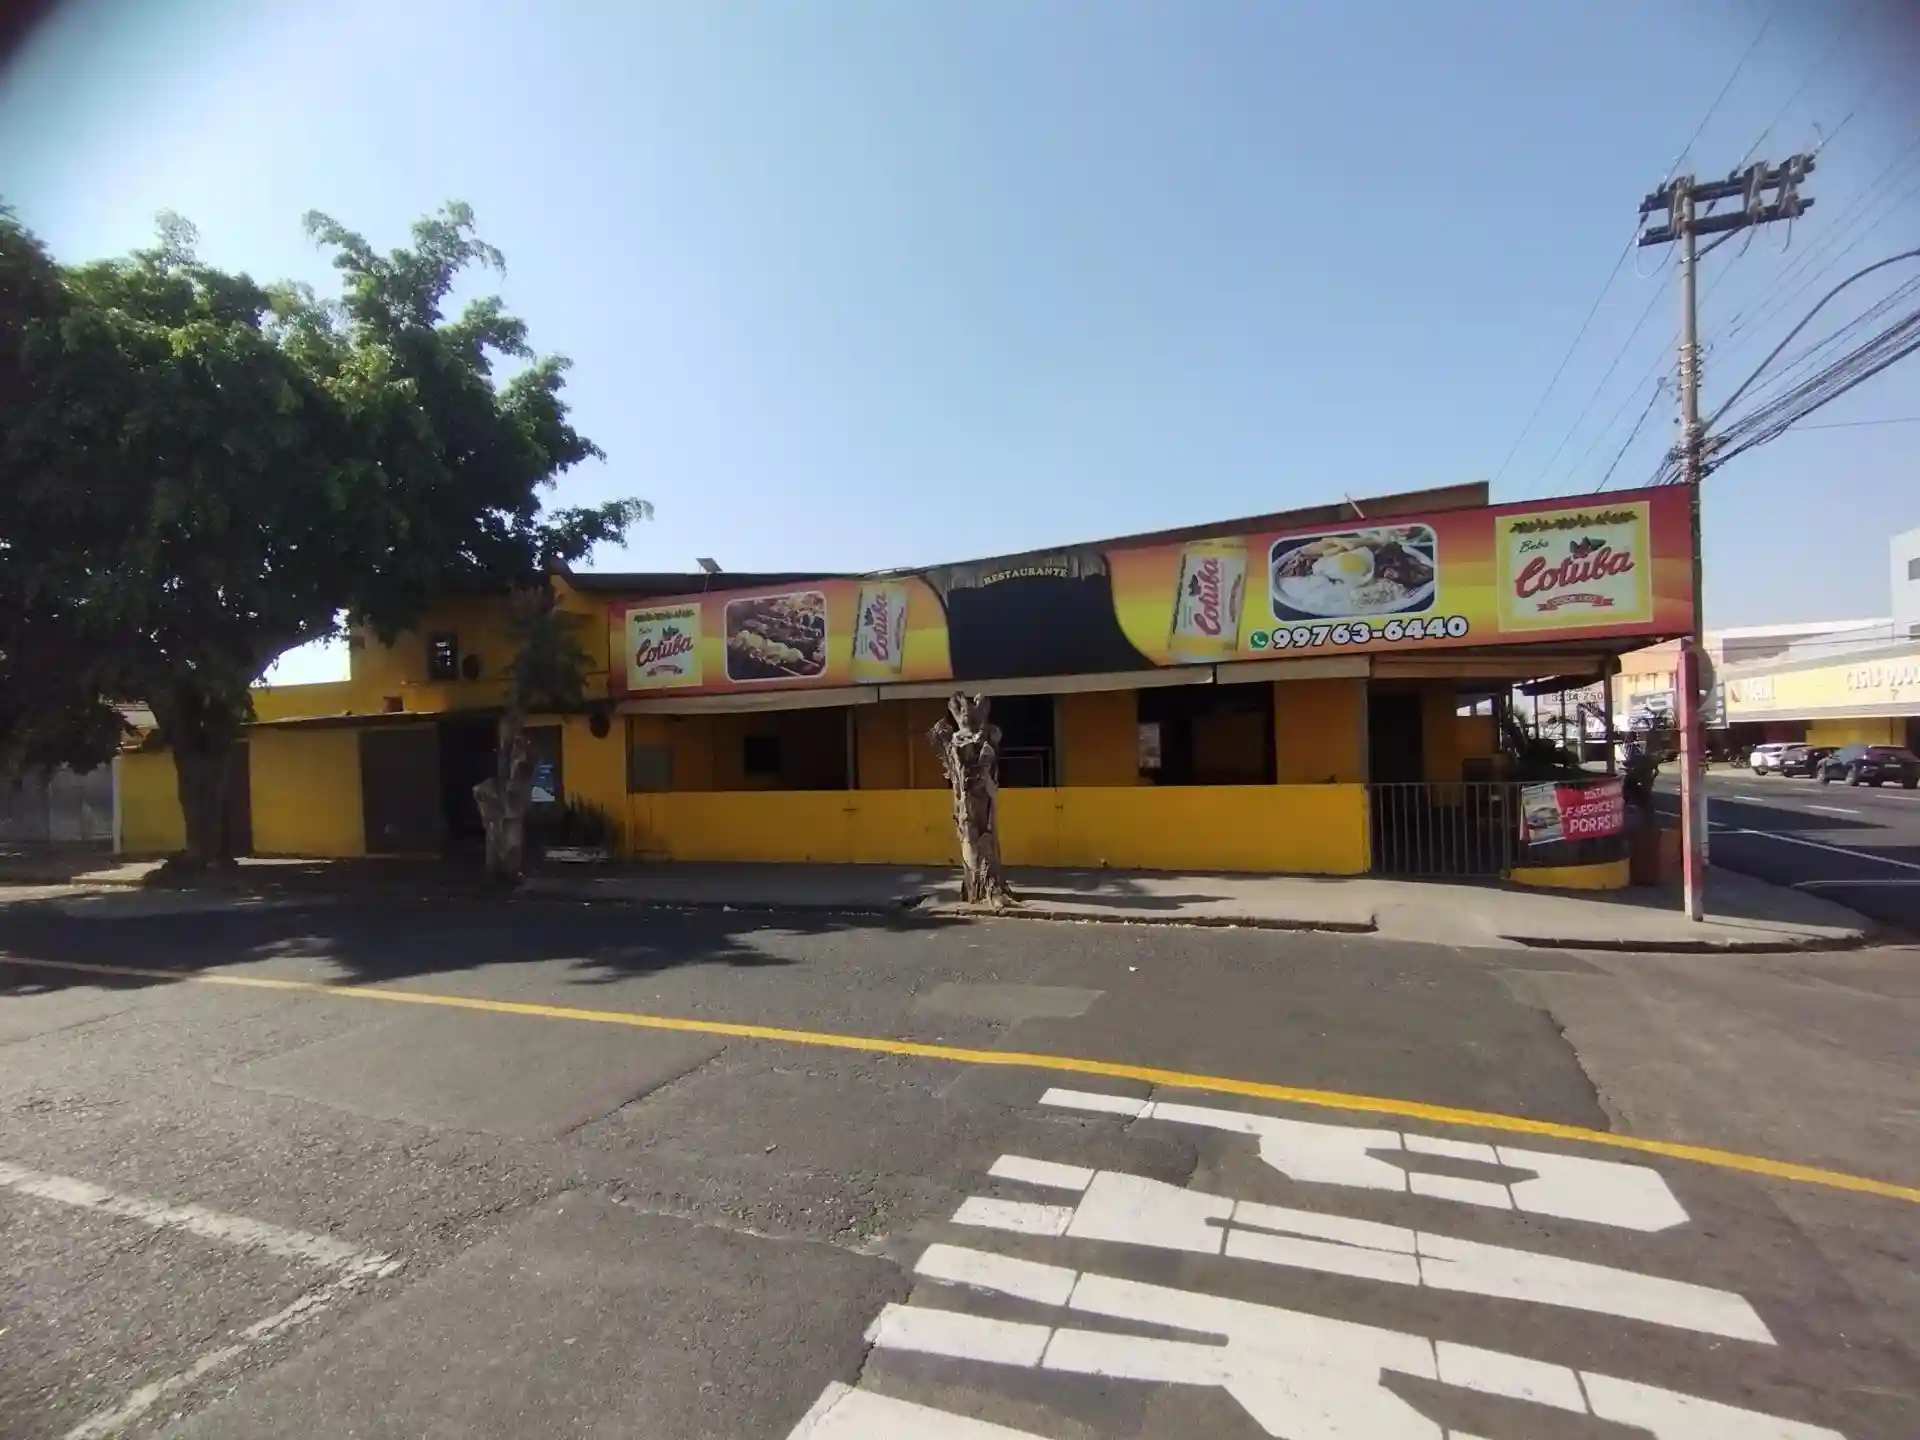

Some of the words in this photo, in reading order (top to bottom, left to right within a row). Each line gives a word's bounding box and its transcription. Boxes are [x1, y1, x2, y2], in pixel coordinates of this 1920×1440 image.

[983, 567, 1068, 585] RESTAURANTE
[1194, 557, 1221, 636] Cotuba
[1514, 546, 1635, 598] Cotuba
[1272, 616, 1468, 649] 99763-6440
[784, 1087, 1846, 1440] PAR
